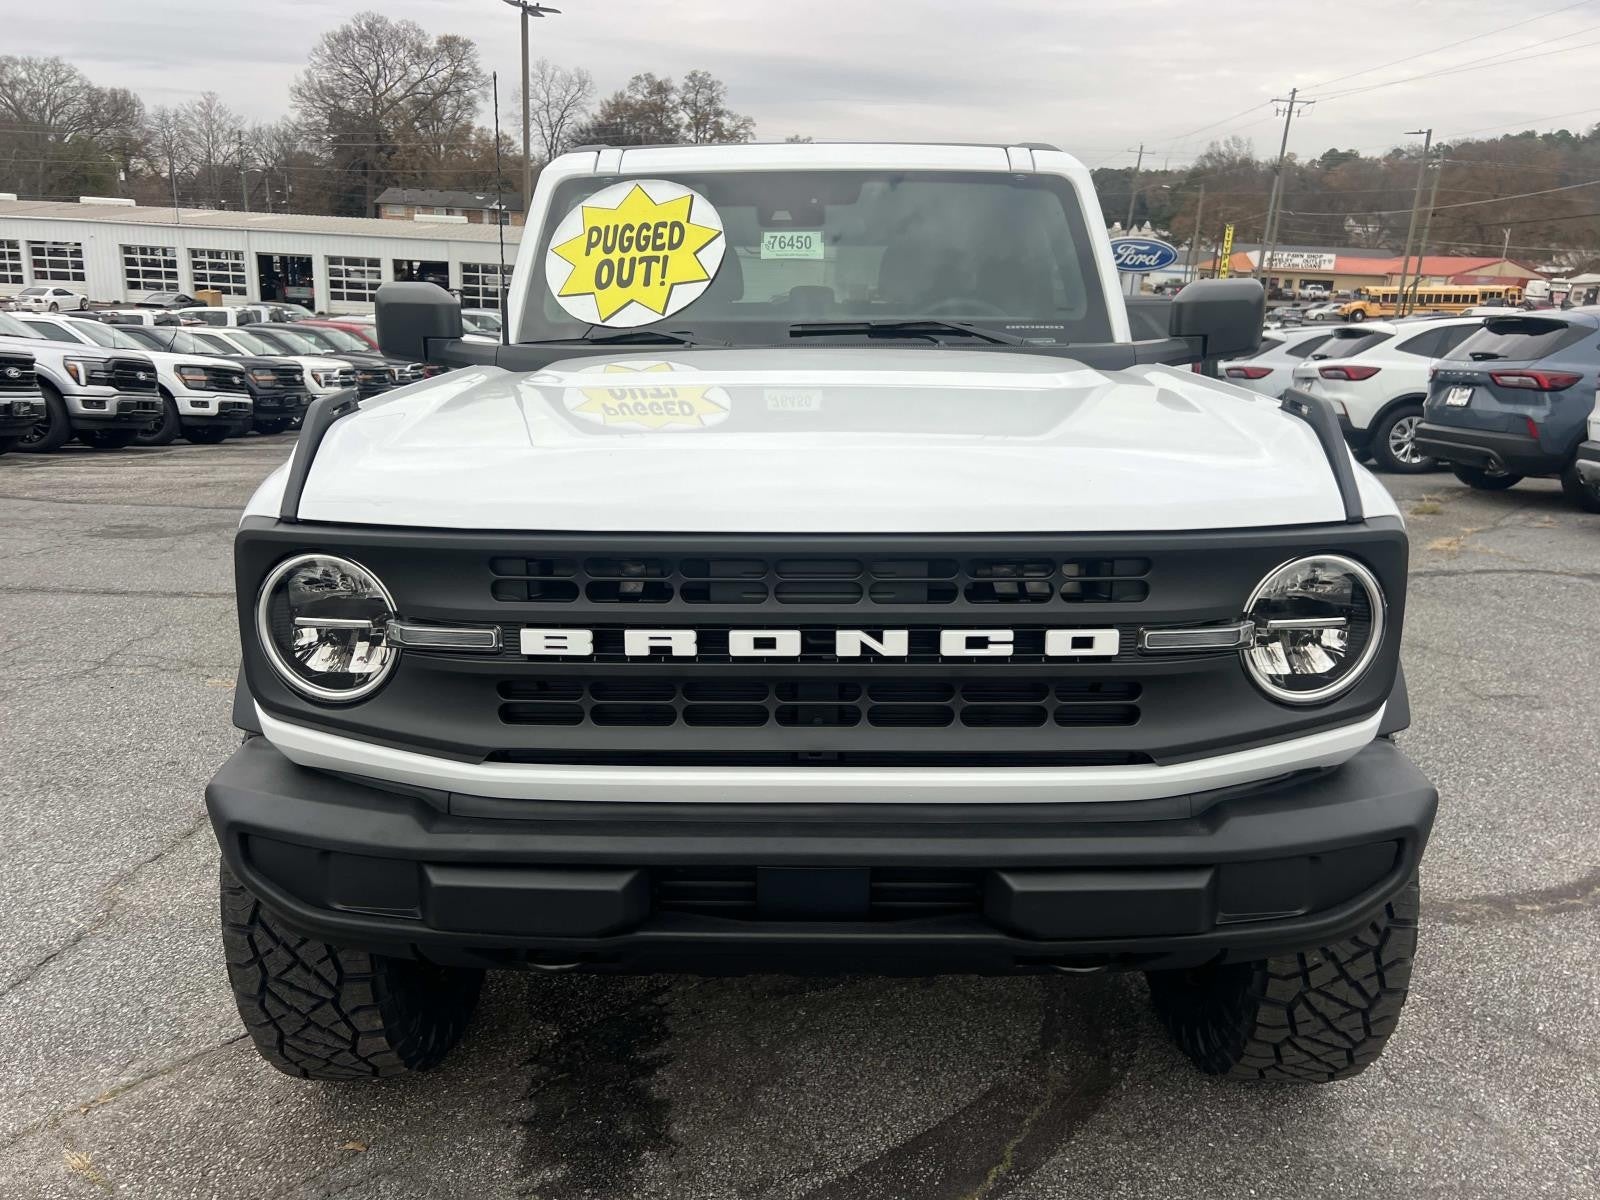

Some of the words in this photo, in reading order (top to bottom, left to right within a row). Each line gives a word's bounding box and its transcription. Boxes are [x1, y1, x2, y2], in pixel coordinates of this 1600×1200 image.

[585, 220, 685, 257] PUGGED
[768, 235, 812, 250] 76450
[1114, 243, 1162, 266] Ford
[594, 255, 669, 290] OUT!
[520, 627, 1120, 658] BRONCO
